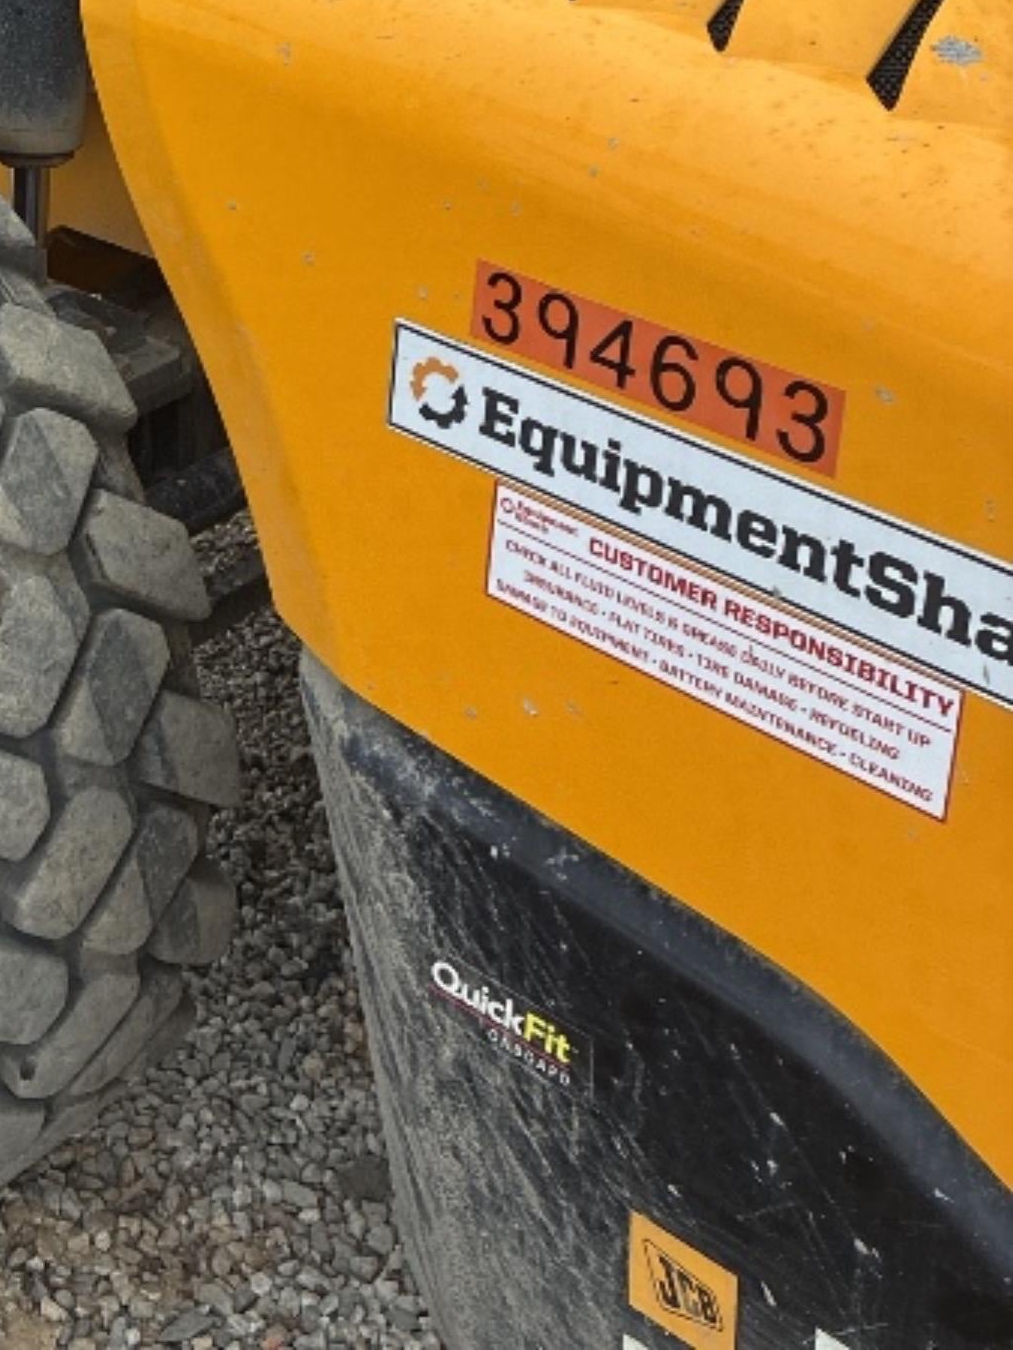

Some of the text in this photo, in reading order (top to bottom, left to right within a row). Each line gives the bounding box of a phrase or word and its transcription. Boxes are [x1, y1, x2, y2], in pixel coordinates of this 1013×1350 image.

[481, 271, 829, 464] 394693
[549, 558, 572, 580] ALL
[787, 670, 849, 711] BEFORE
[851, 700, 905, 738] START
[907, 726, 932, 751] UP
[589, 535, 954, 720] CUSTOMER RESPONSIBILITY
[849, 750, 933, 805] CLEANING
[431, 961, 570, 1063] QuickFit
